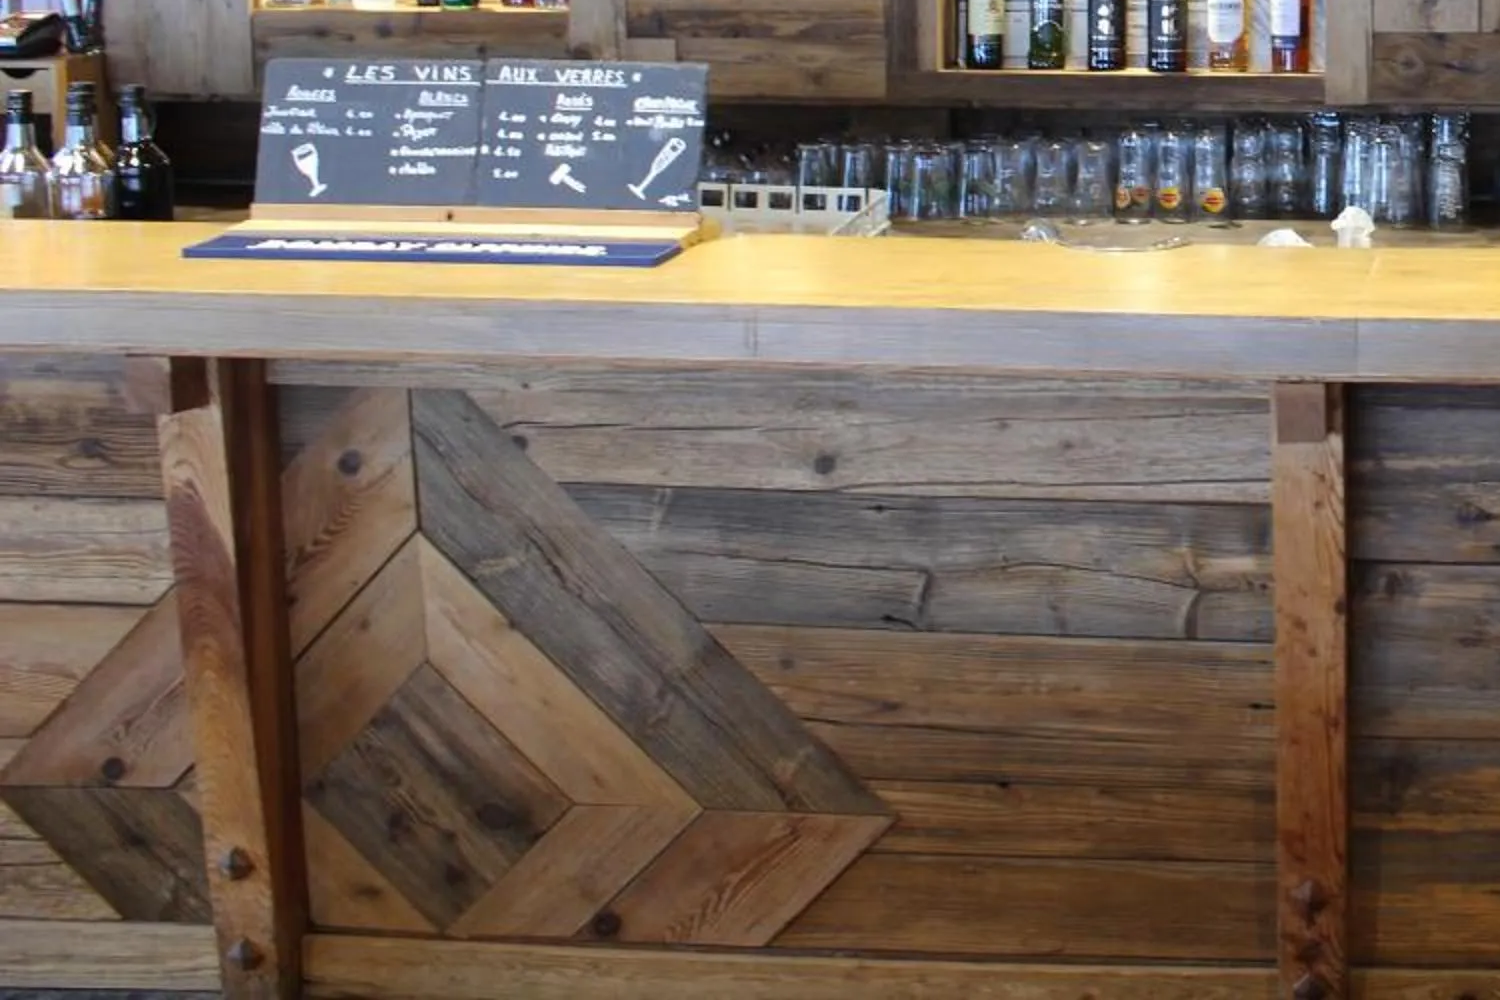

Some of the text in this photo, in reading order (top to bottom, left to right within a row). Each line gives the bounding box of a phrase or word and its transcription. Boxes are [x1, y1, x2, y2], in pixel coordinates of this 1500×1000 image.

[346, 65, 626, 85] LES VINS AUX VERRES
